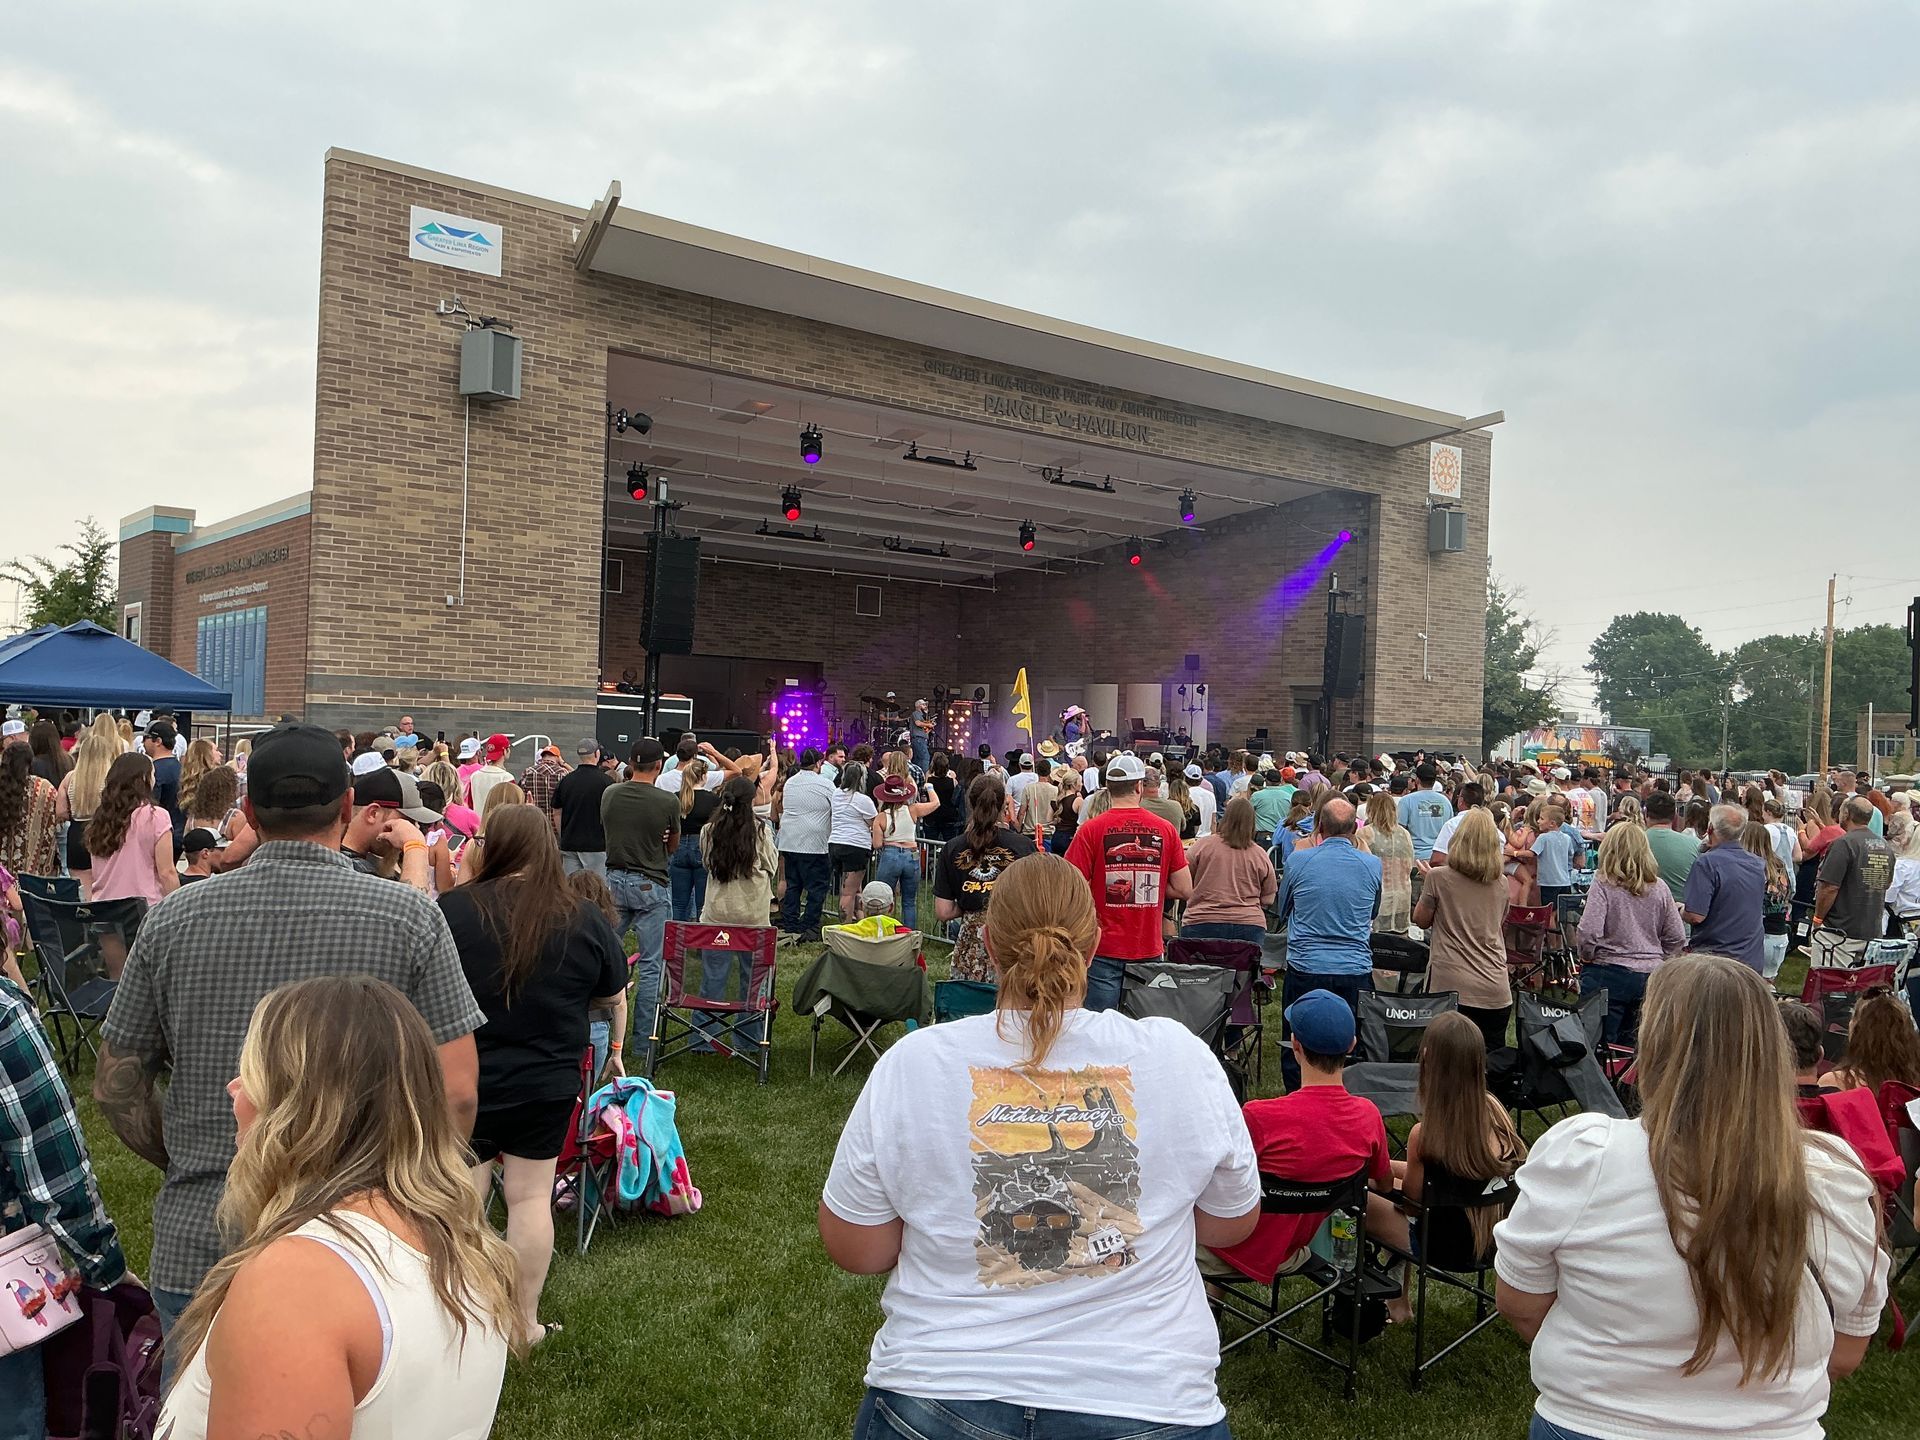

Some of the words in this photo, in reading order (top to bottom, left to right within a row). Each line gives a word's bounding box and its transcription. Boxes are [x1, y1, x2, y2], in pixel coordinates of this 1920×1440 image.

[468, 243, 489, 253] REGION
[924, 359, 980, 383] GREATER
[1062, 389, 1092, 407] PARK
[1095, 395, 1118, 412] AND
[1118, 400, 1198, 428] AMPHITHEATER
[984, 394, 1053, 425] PANGLE
[1077, 413, 1150, 443] PAVILION
[1107, 827, 1160, 835] MUSTANG
[1386, 1008, 1416, 1020] UNOH
[1541, 1006, 1571, 1018] UNOH
[976, 1104, 1053, 1126] Nuthin
[1053, 1105, 1112, 1129] Fancy
[1269, 1189, 1304, 1198] OZARK
[1305, 1190, 1330, 1198] TRAIL
